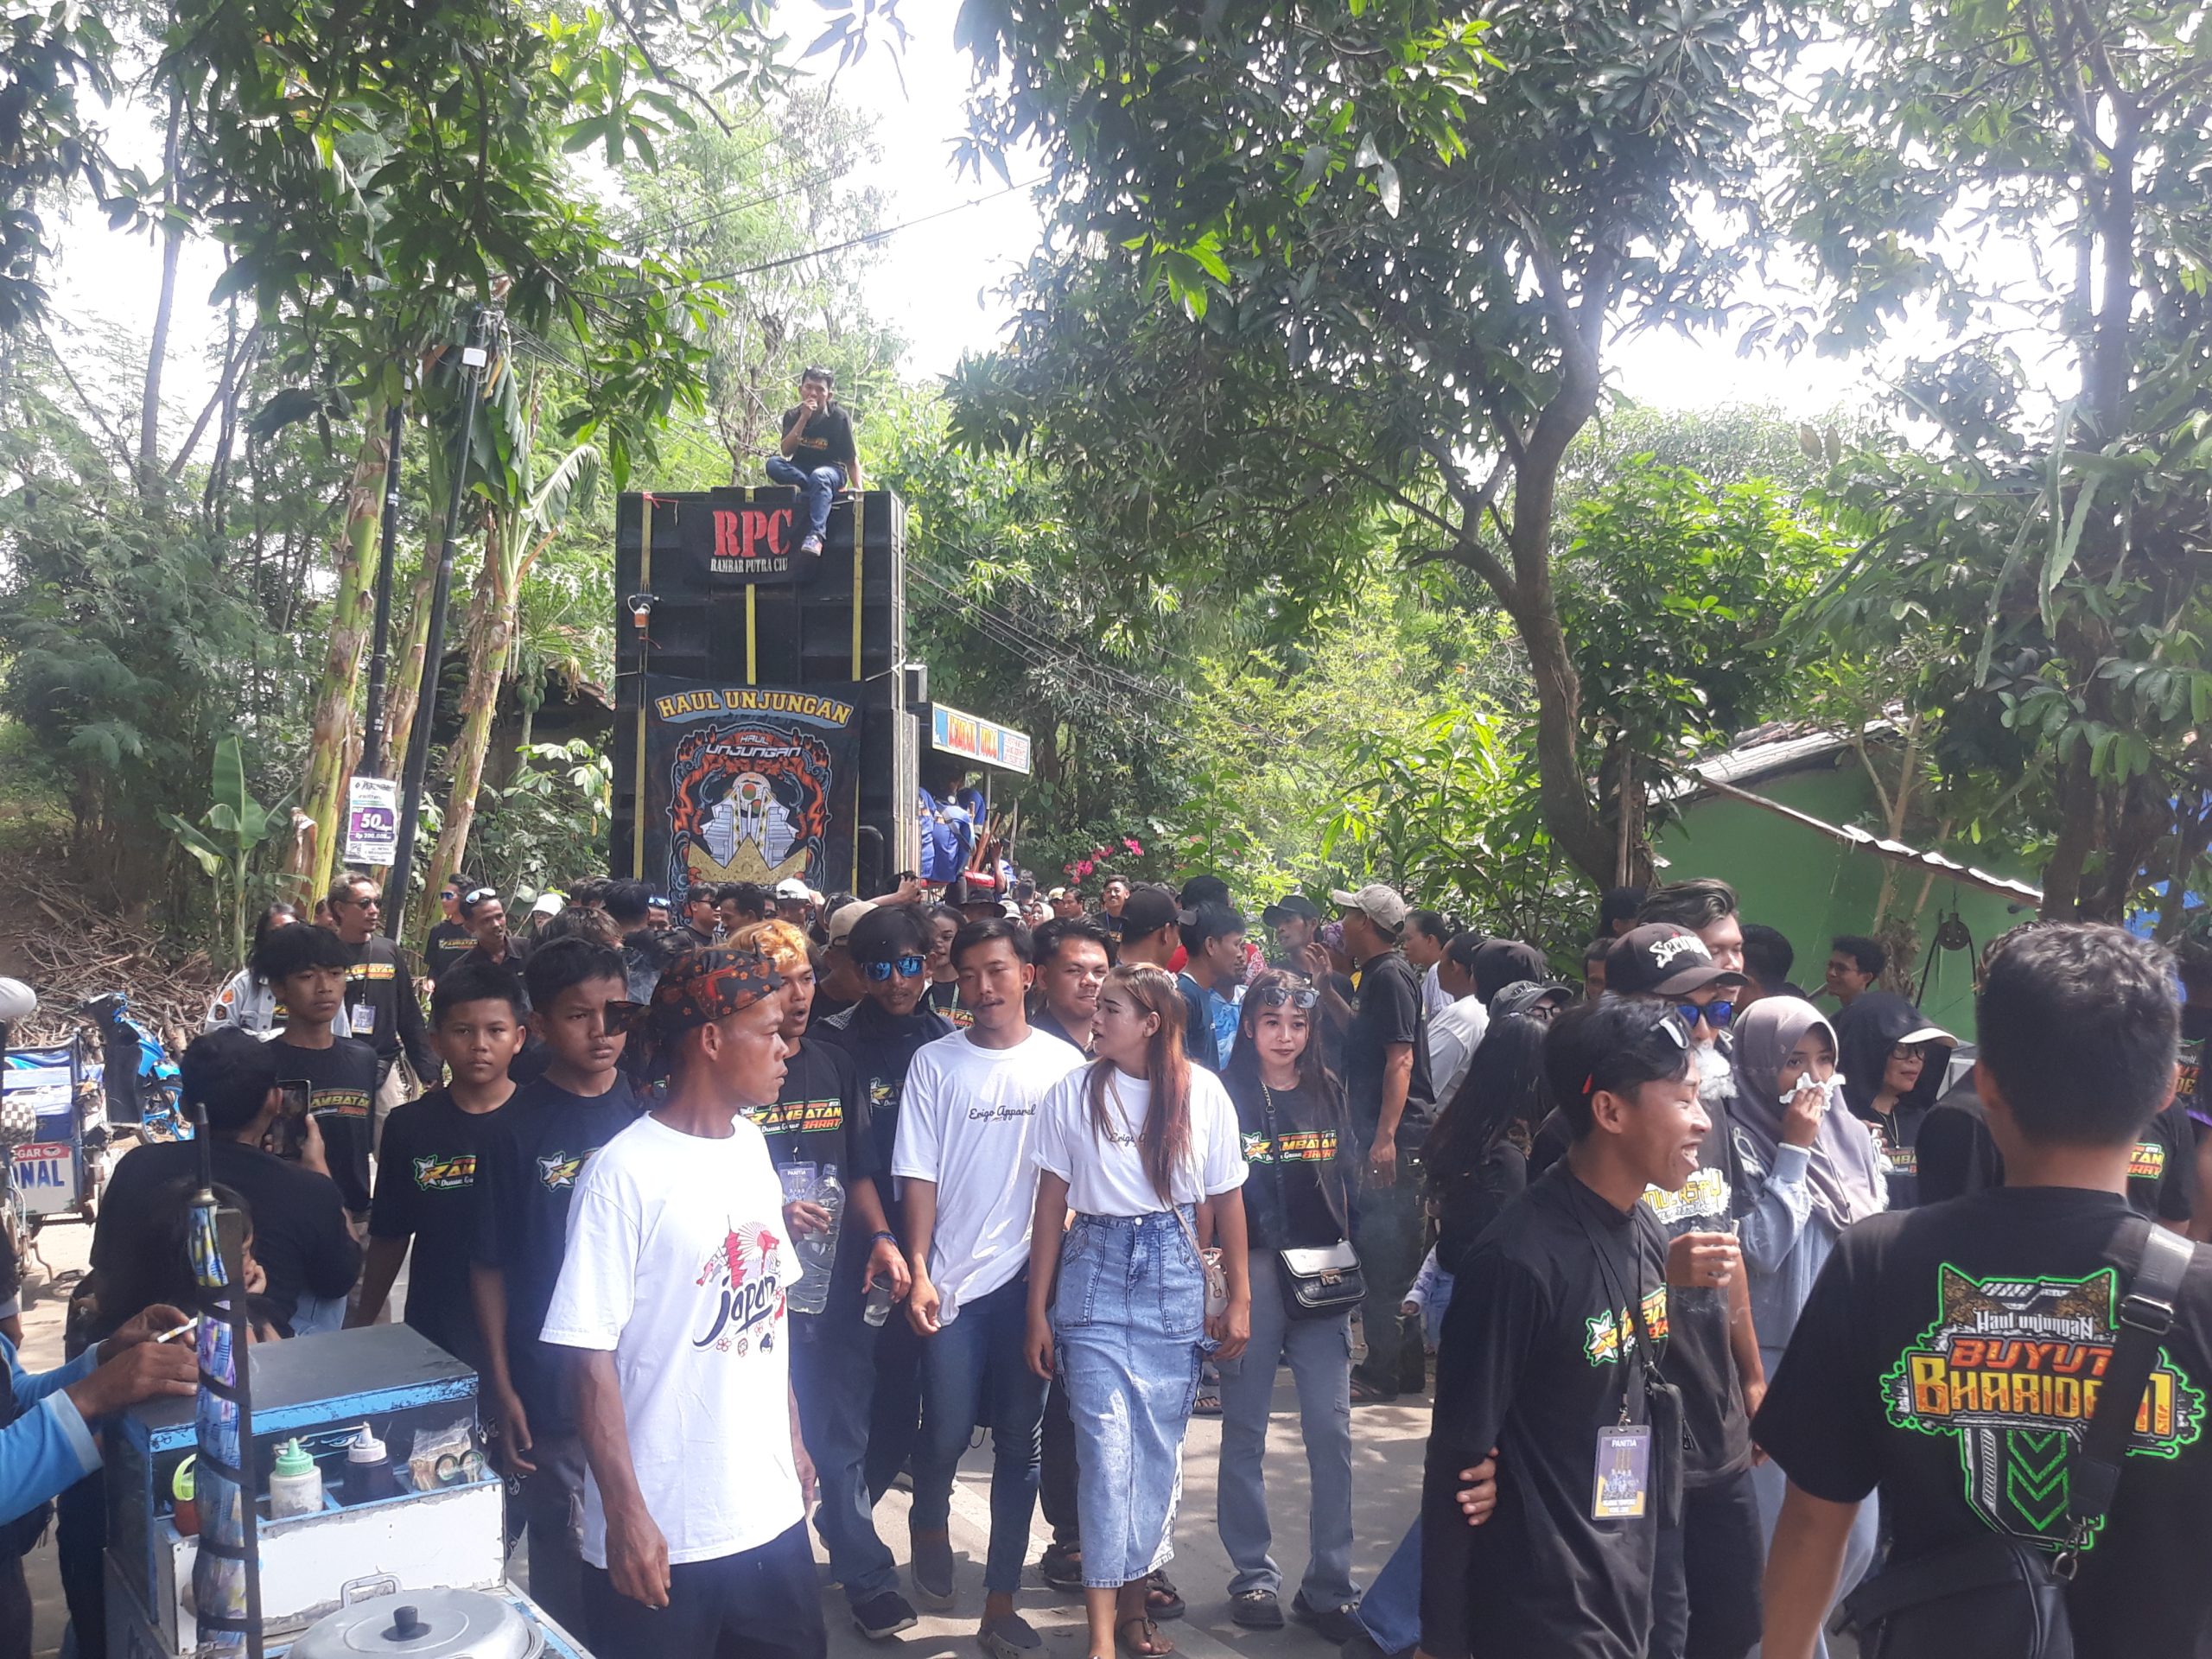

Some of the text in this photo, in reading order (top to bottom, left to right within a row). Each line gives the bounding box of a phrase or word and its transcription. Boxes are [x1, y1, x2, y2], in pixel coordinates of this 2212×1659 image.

[712, 508, 792, 557] RPC
[710, 558, 788, 573] RAMBAR PUTRA CIU
[658, 691, 851, 725] HAUL UNJUNGAN
[360, 813, 382, 829] 50
[802, 1118, 842, 1129] BARAT
[969, 1104, 1036, 1122] Erigo Apparel
[693, 1274, 776, 1347] japan
[1973, 1306, 2015, 1334] Haul
[1949, 1339, 2114, 1376] BUYUT
[1611, 1439, 1637, 1447] PANITIA
